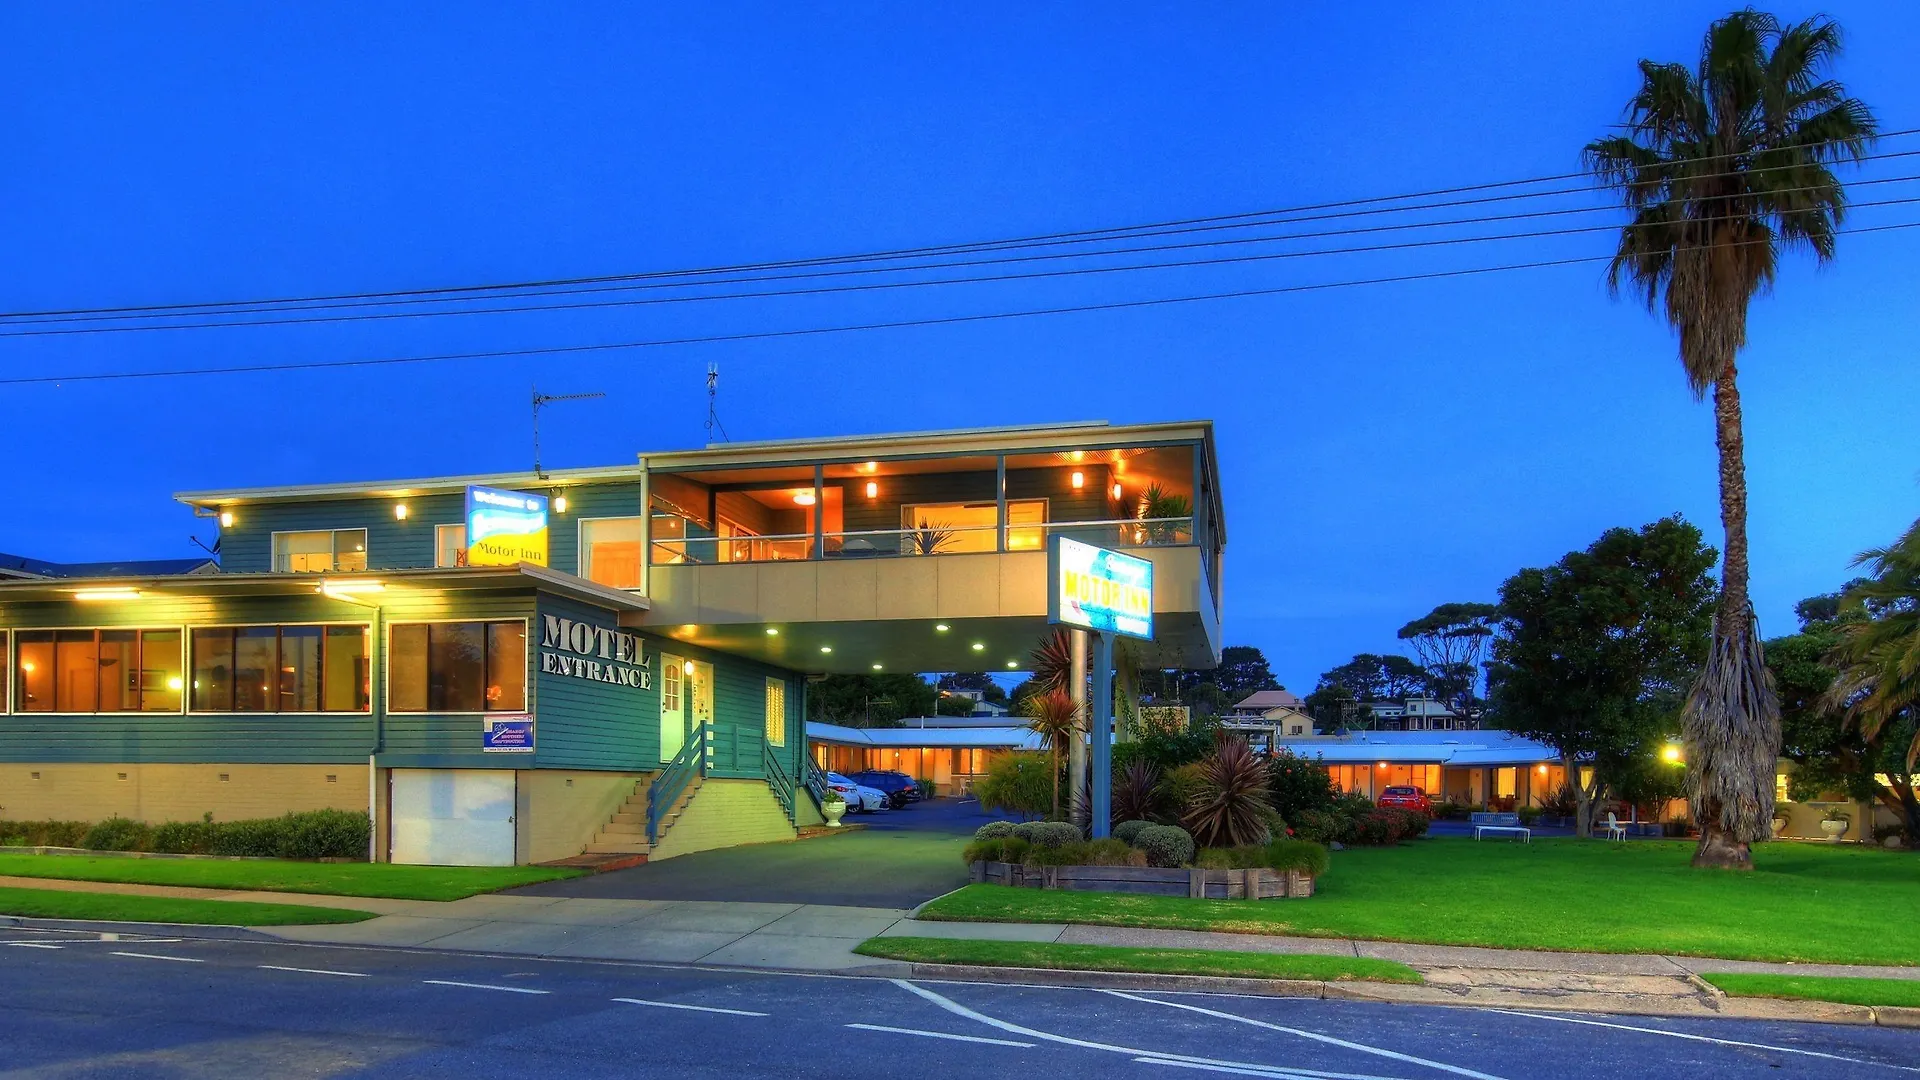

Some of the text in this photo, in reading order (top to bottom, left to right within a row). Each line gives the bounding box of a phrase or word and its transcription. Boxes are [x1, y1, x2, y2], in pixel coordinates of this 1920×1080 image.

[478, 542, 541, 560] Motor Inn
[1065, 569, 1120, 612] MOTOR
[1124, 585, 1149, 616] INN
[541, 613, 652, 669] MOTEL
[541, 651, 652, 691] ENTRANCE
